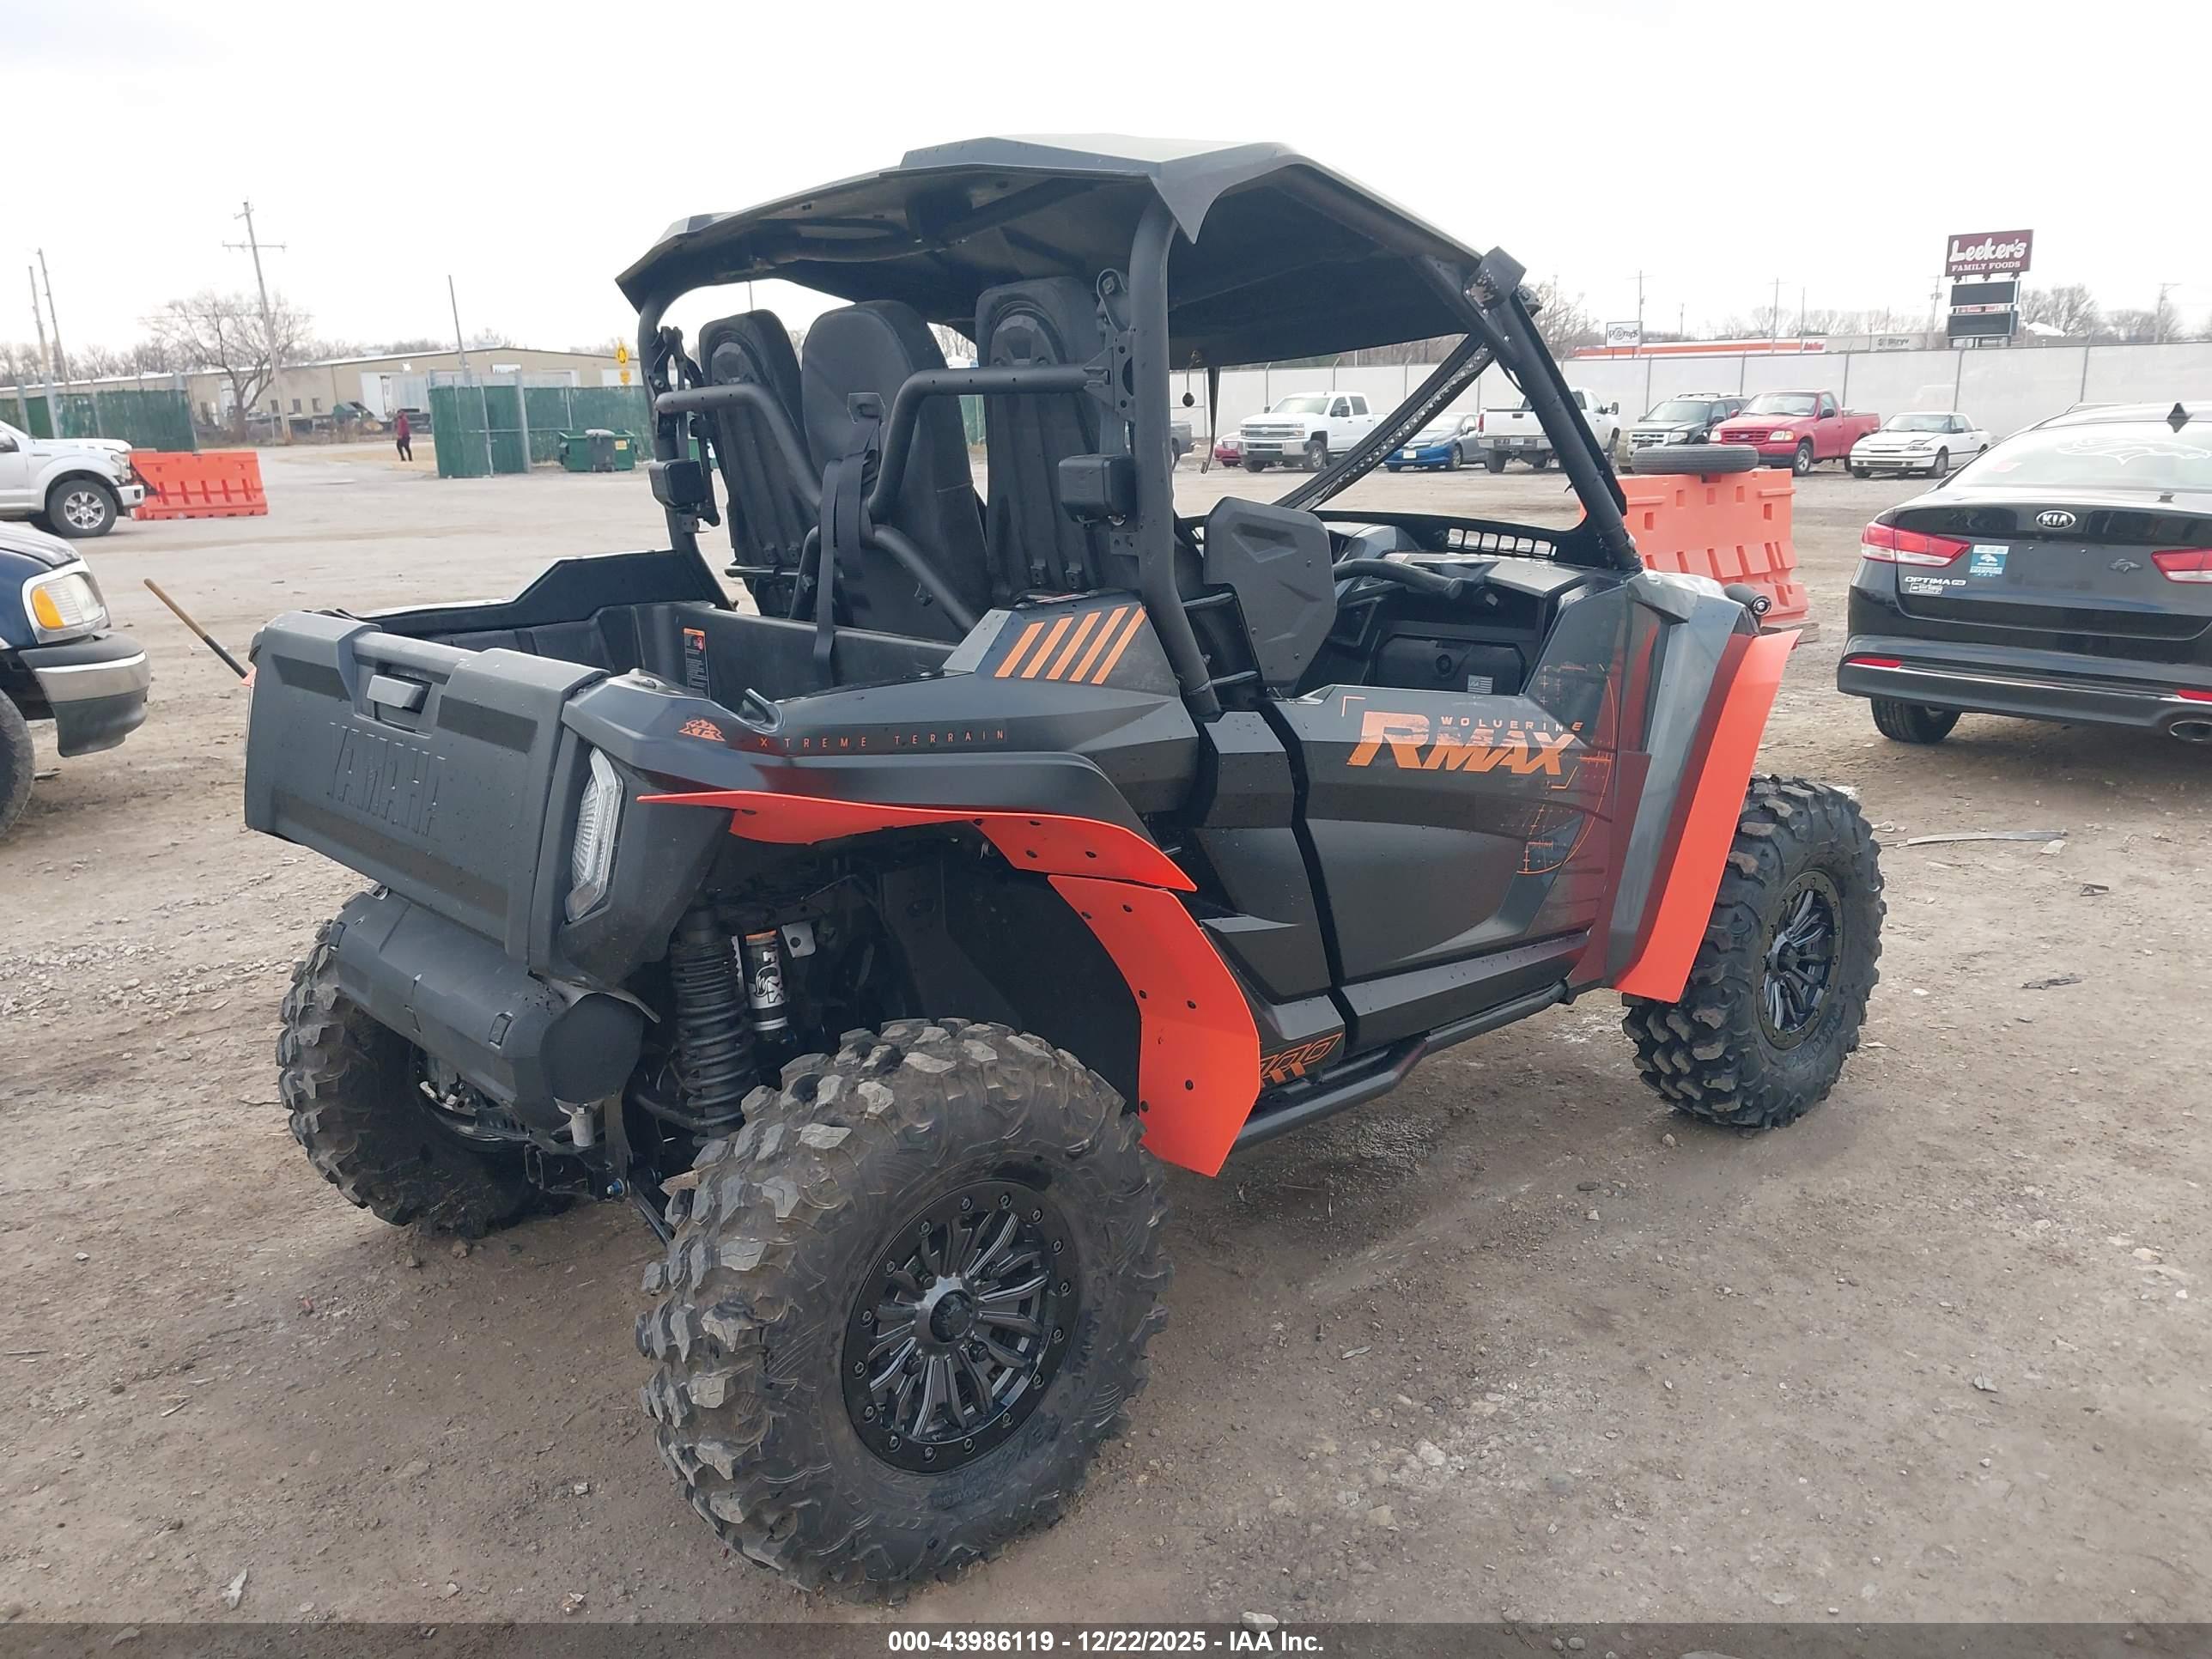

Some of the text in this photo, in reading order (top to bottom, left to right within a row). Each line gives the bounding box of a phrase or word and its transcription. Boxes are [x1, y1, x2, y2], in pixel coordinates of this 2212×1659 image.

[1949, 238, 2027, 262] Leeker's
[1952, 263, 1986, 271] FAMILY
[2043, 514, 2068, 526] KIA
[1905, 576, 1950, 586] OPTIMA
[760, 729, 1005, 750] XTREME TERRAIN
[1346, 711, 1576, 775] RMAX
